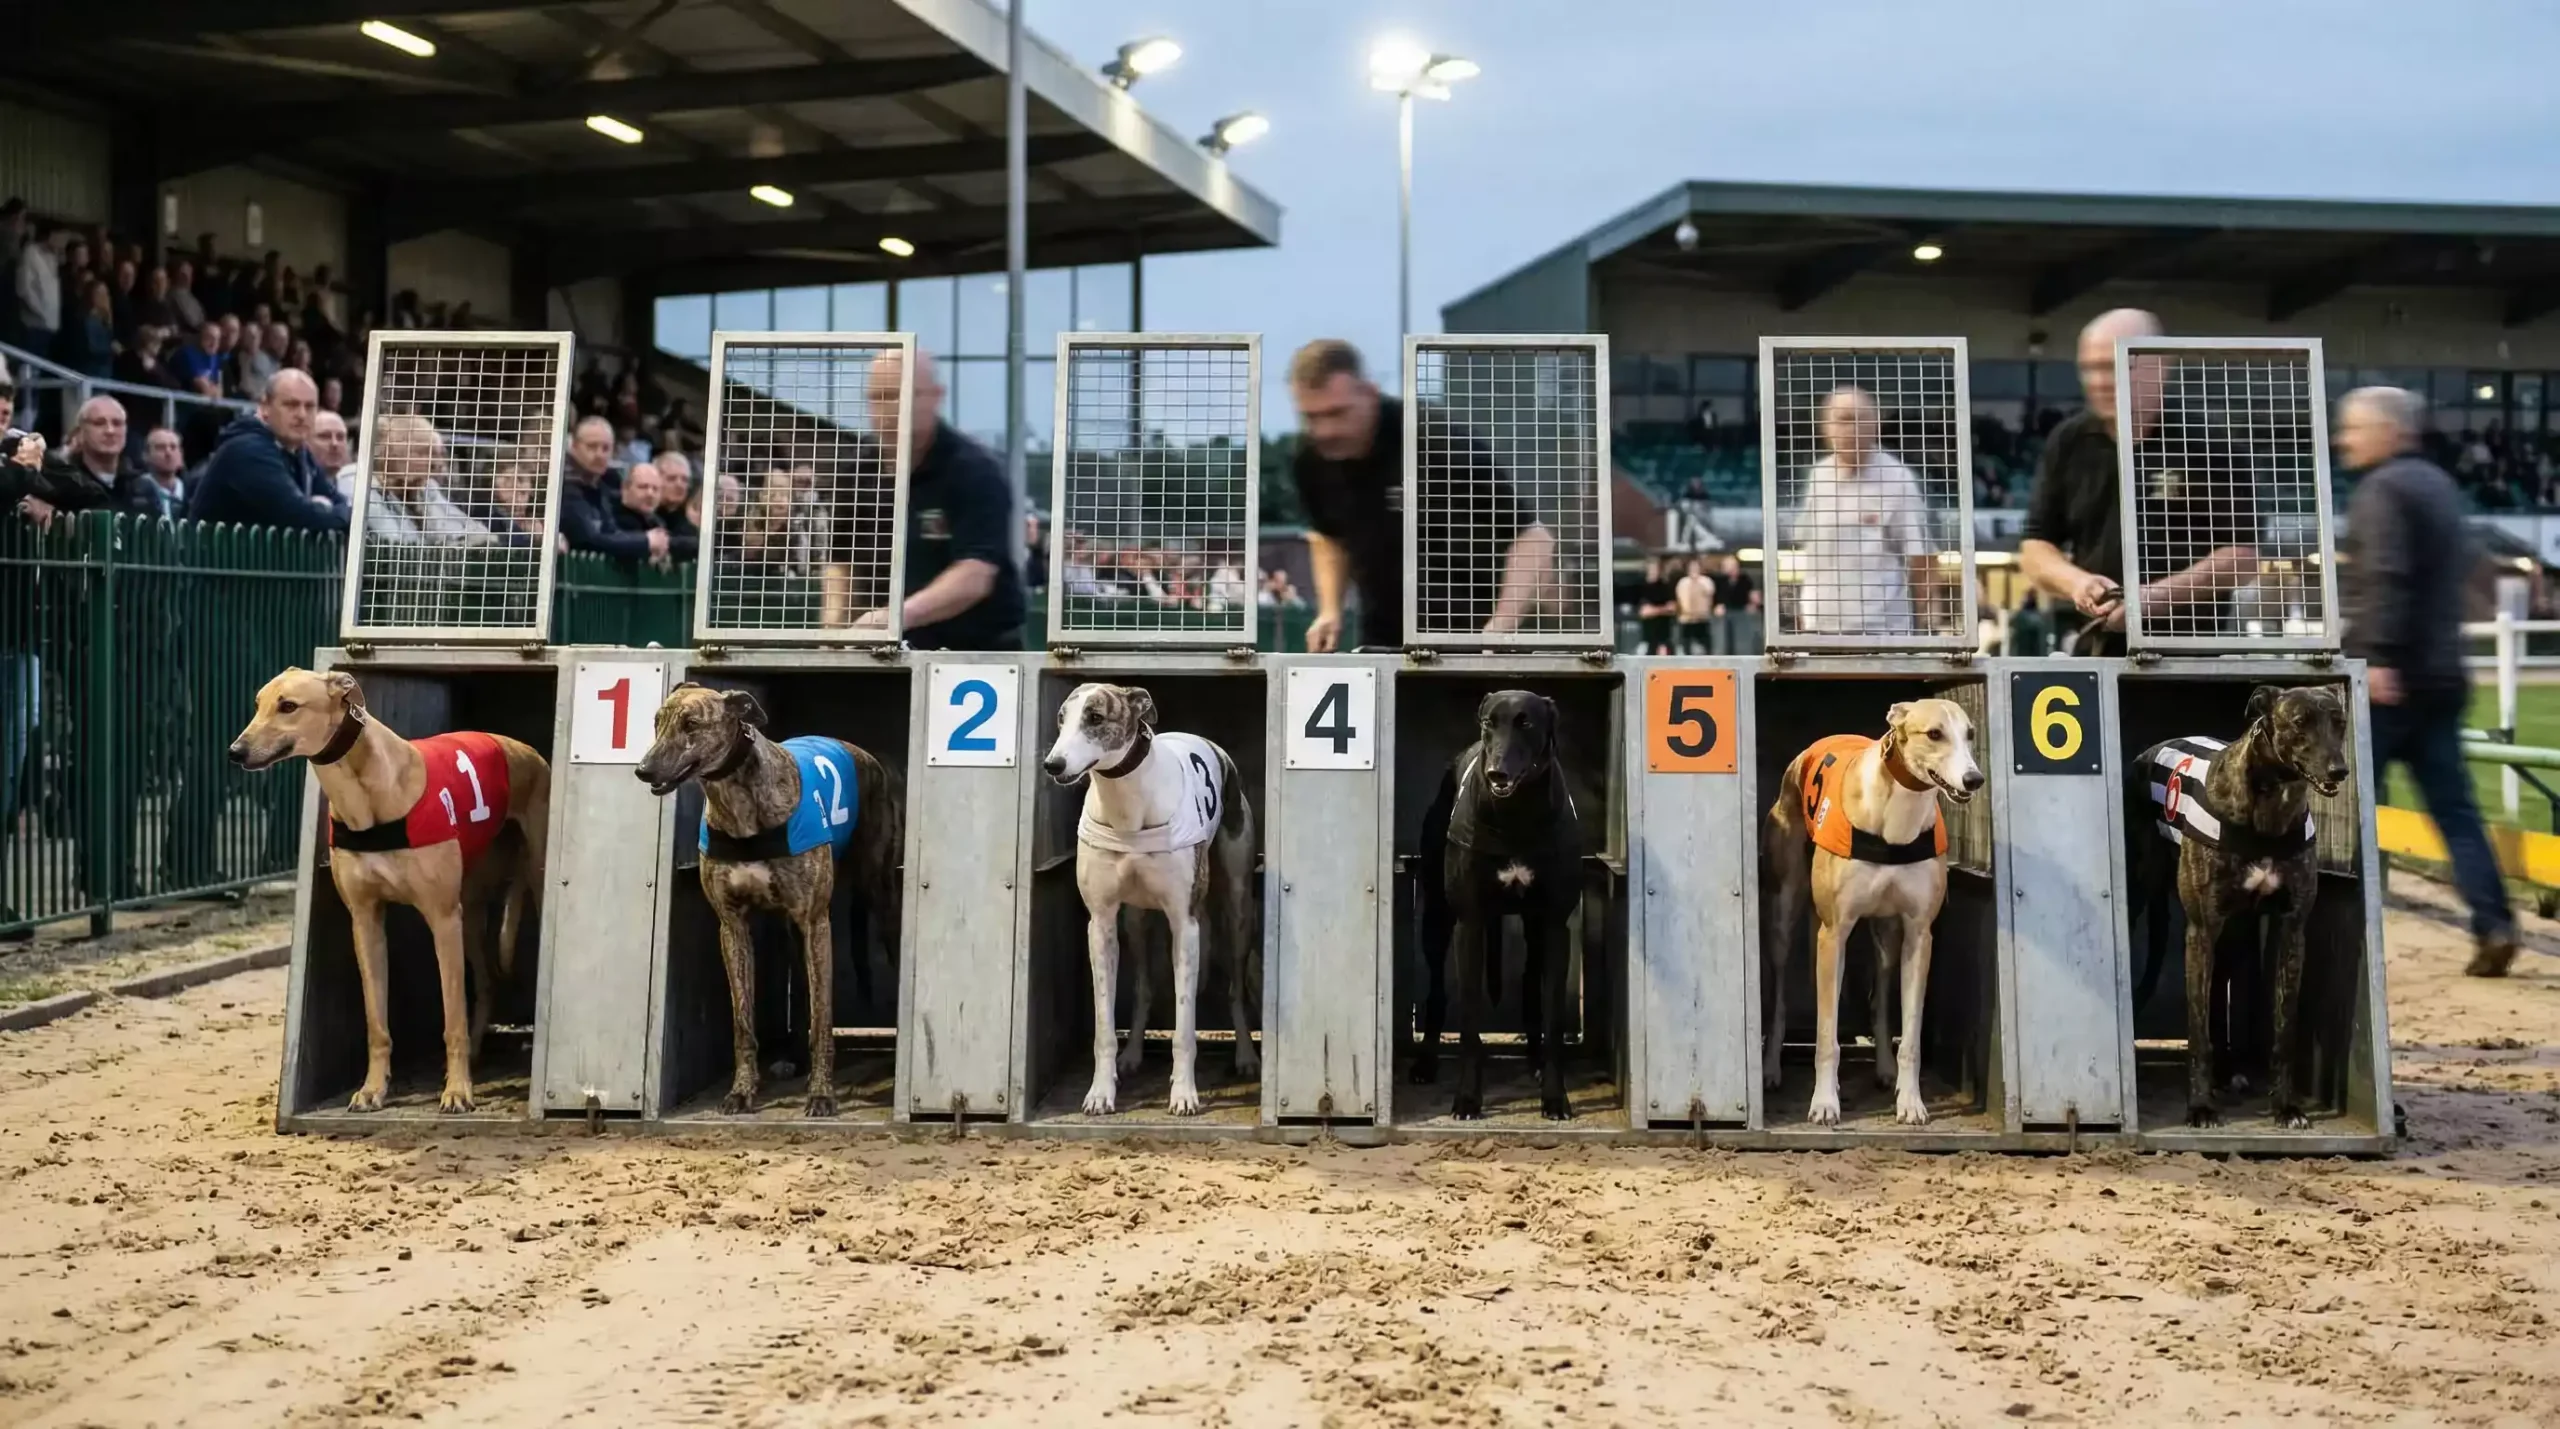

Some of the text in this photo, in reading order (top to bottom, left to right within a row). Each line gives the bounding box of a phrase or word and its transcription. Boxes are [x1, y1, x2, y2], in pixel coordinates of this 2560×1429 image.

[599, 678, 630, 749] 1
[946, 680, 998, 752] 2
[1304, 683, 1356, 754] 4
[1667, 685, 1717, 758] 5
[2030, 686, 2083, 760] 6
[455, 749, 490, 823] 1
[813, 755, 849, 826] 2
[1189, 752, 1217, 821] 3
[1807, 752, 1837, 821] 5
[2164, 756, 2194, 822] 6
